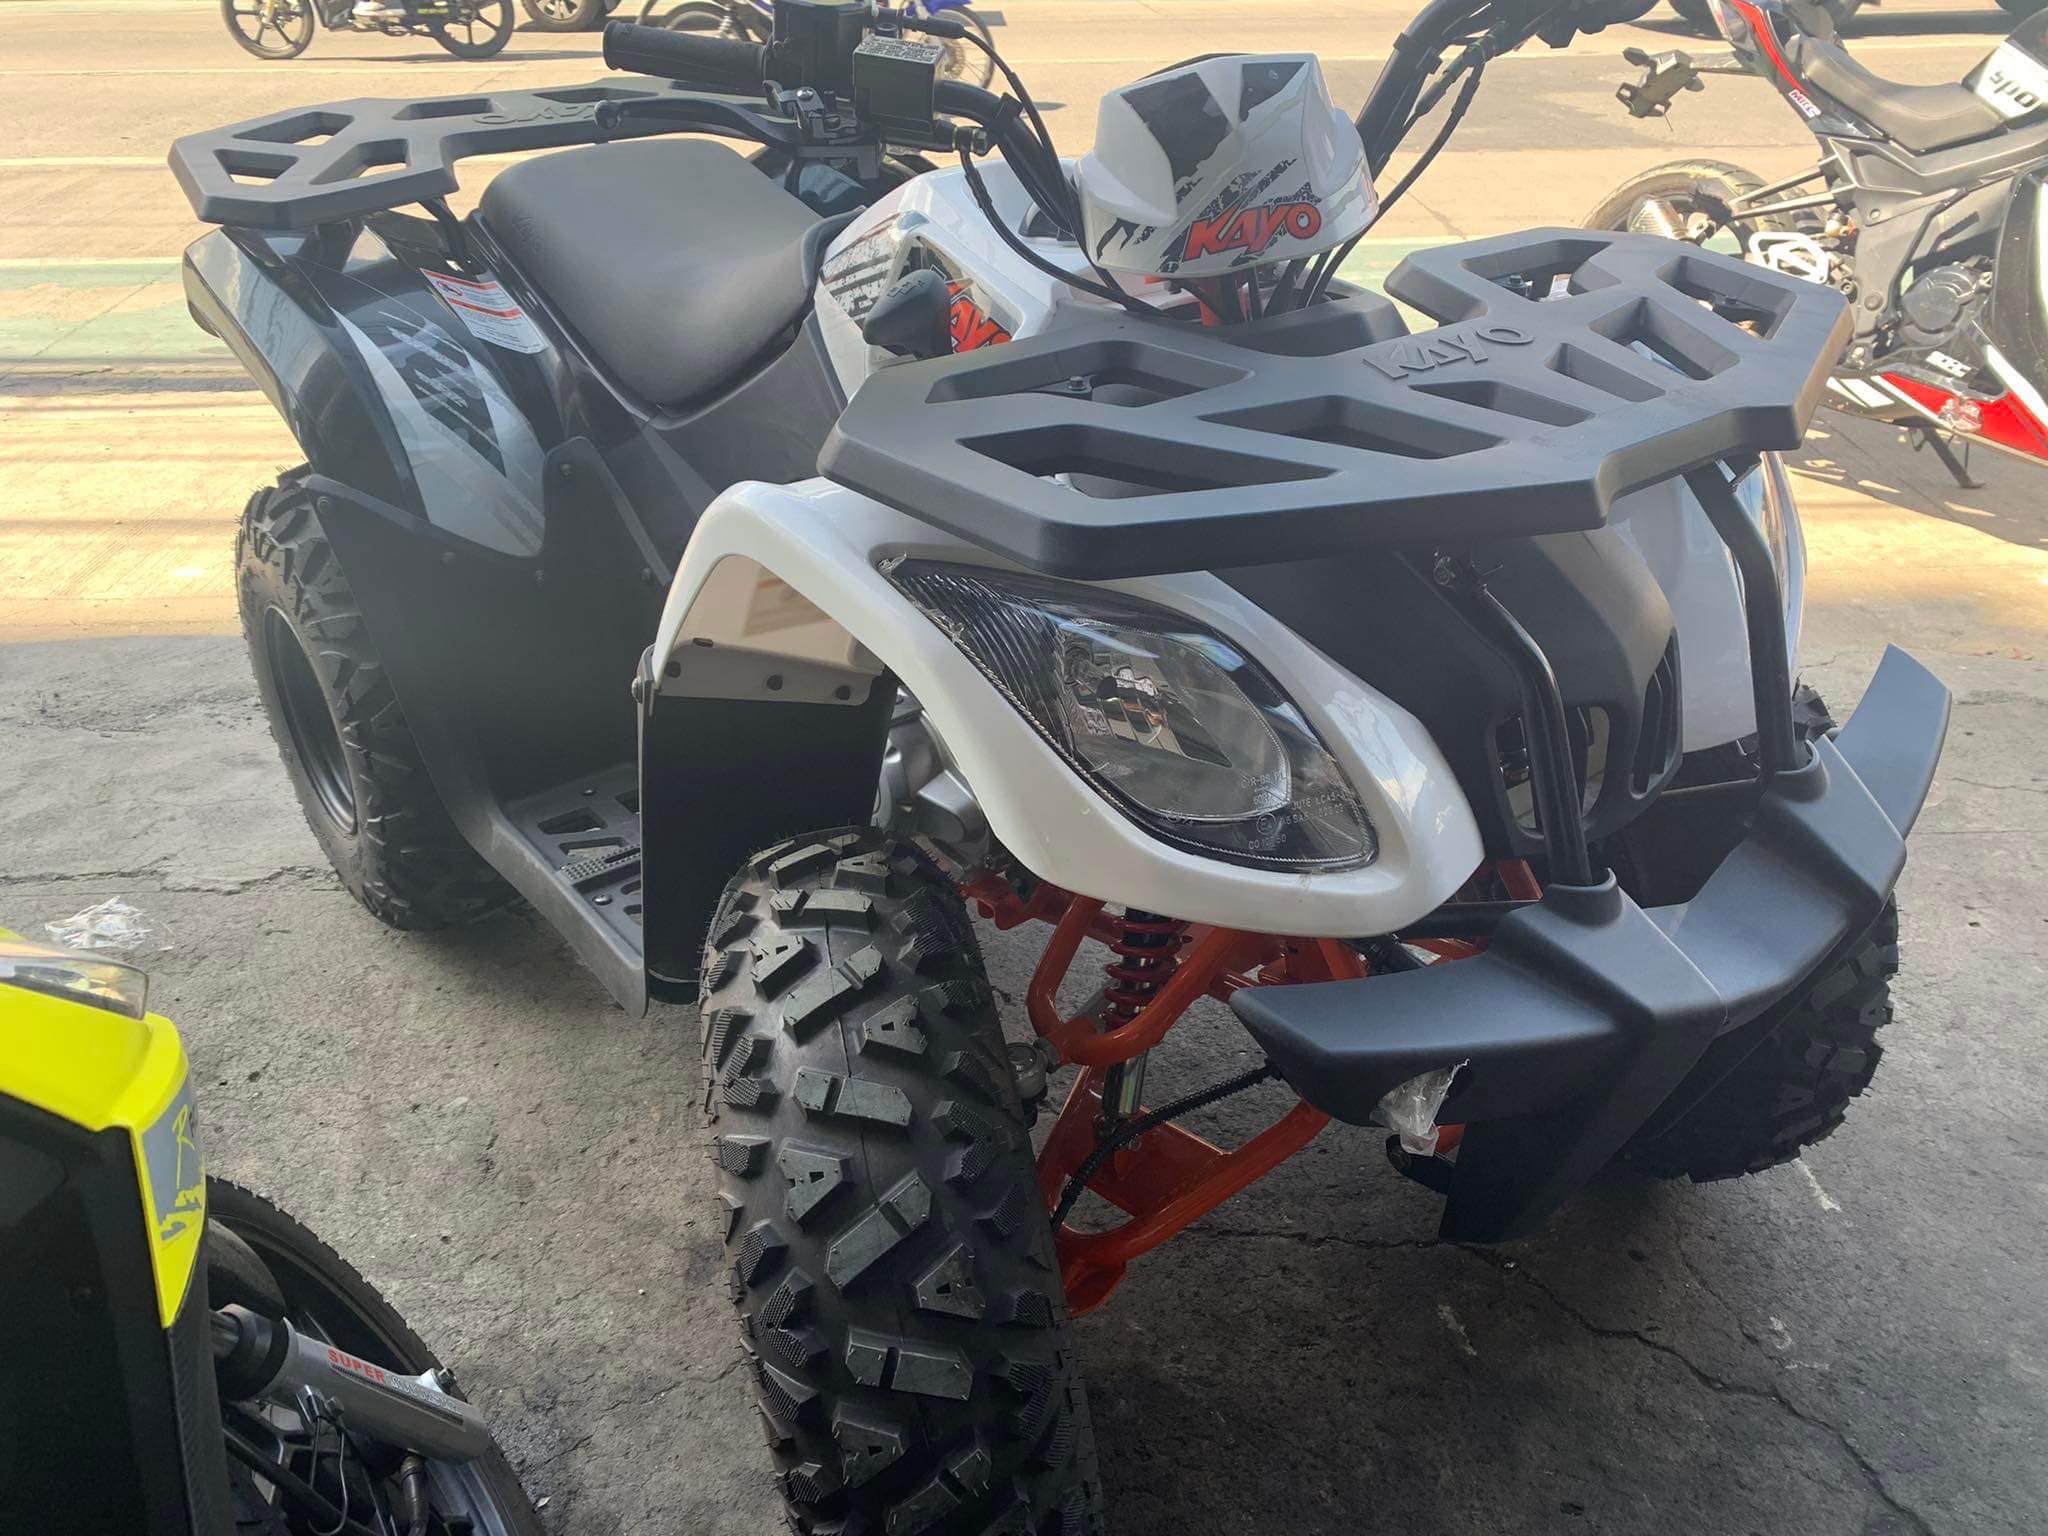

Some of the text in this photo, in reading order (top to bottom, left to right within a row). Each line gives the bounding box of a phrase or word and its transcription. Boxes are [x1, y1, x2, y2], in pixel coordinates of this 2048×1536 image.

[1182, 201, 1322, 262] KAYO
[1362, 326, 1536, 381] KAYO
[327, 1347, 386, 1385] SUPER
